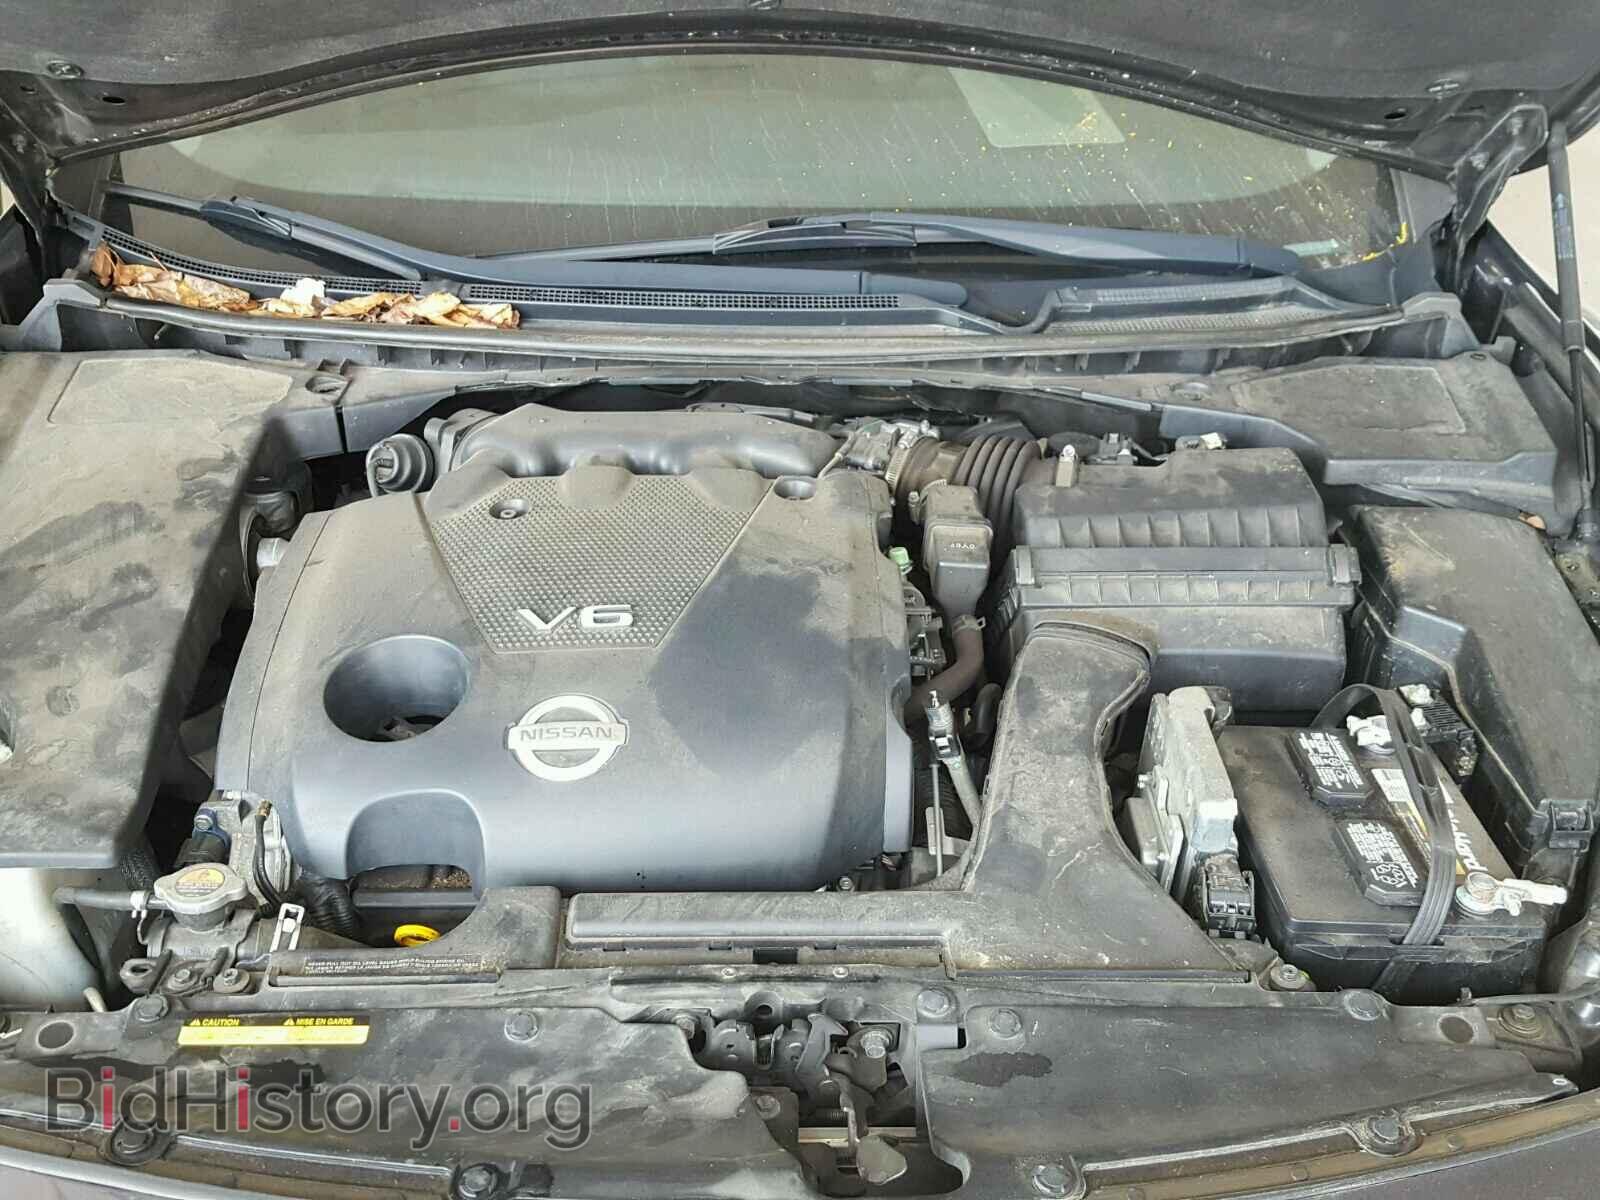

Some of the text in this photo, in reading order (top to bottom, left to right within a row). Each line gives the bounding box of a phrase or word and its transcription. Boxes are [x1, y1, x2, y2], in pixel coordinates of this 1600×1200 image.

[517, 604, 634, 631] V6
[519, 726, 613, 742] NISSAN
[202, 1018, 240, 1026] CAUTION
[296, 1017, 354, 1025] MISE EN GARDE
